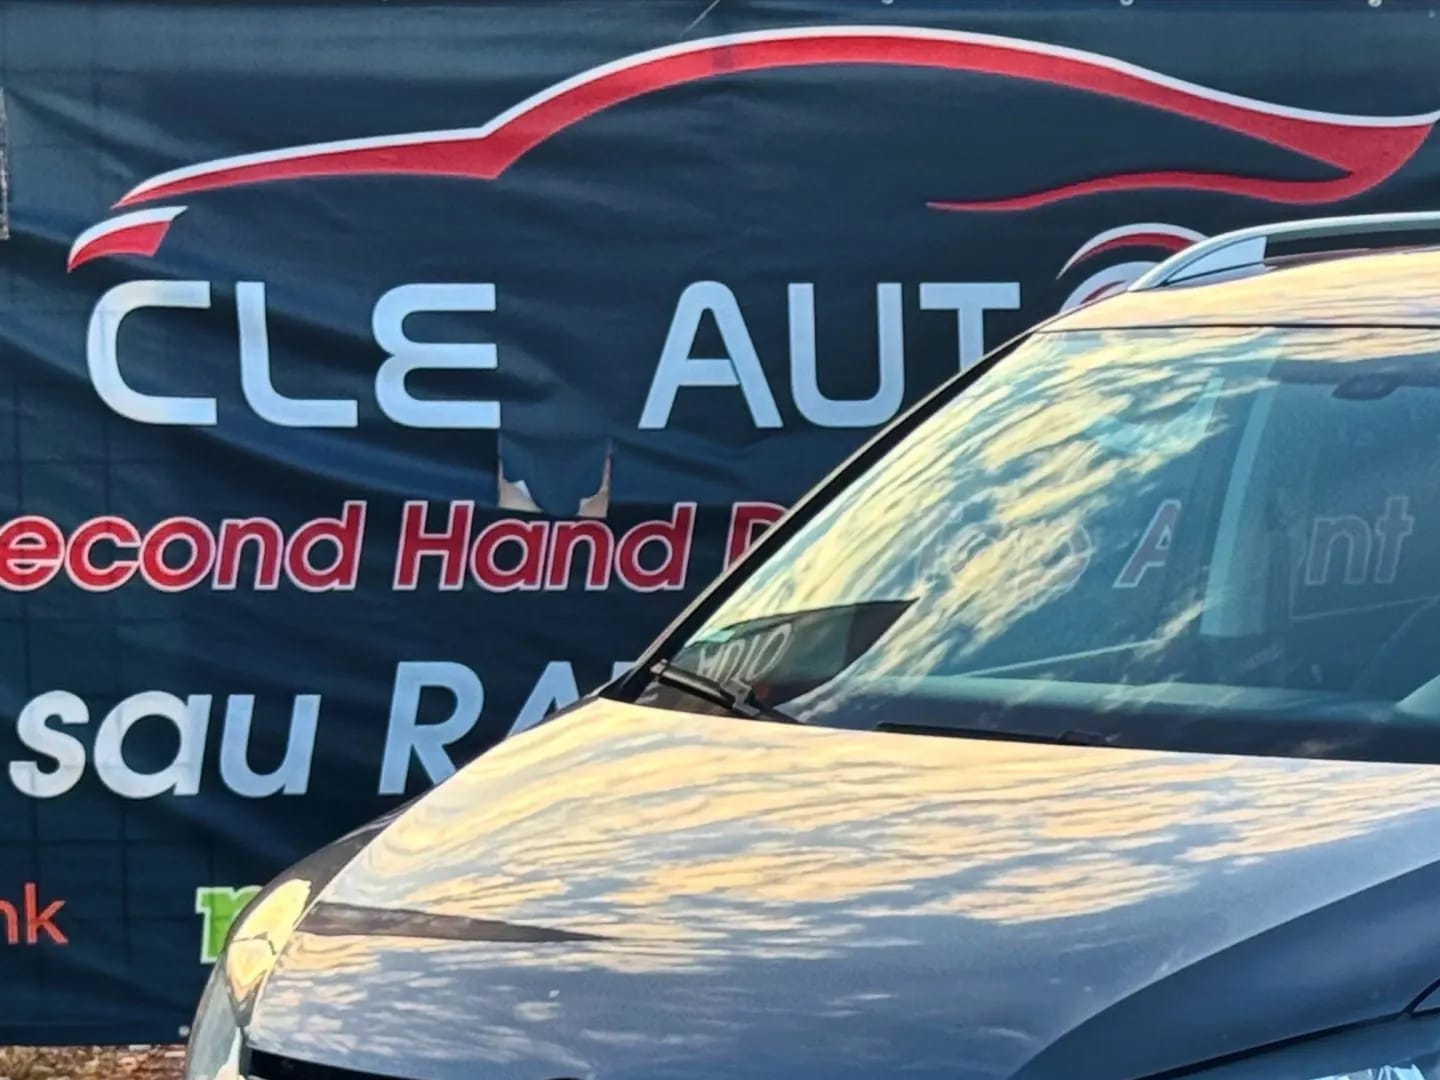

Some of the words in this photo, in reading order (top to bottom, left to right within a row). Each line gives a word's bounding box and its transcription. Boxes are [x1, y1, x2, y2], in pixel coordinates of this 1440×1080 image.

[86, 280, 500, 429] CLE
[637, 262, 1160, 430] AUT
[0, 500, 366, 592] econd
[392, 500, 697, 592] Hand
[9, 690, 322, 798] sau
